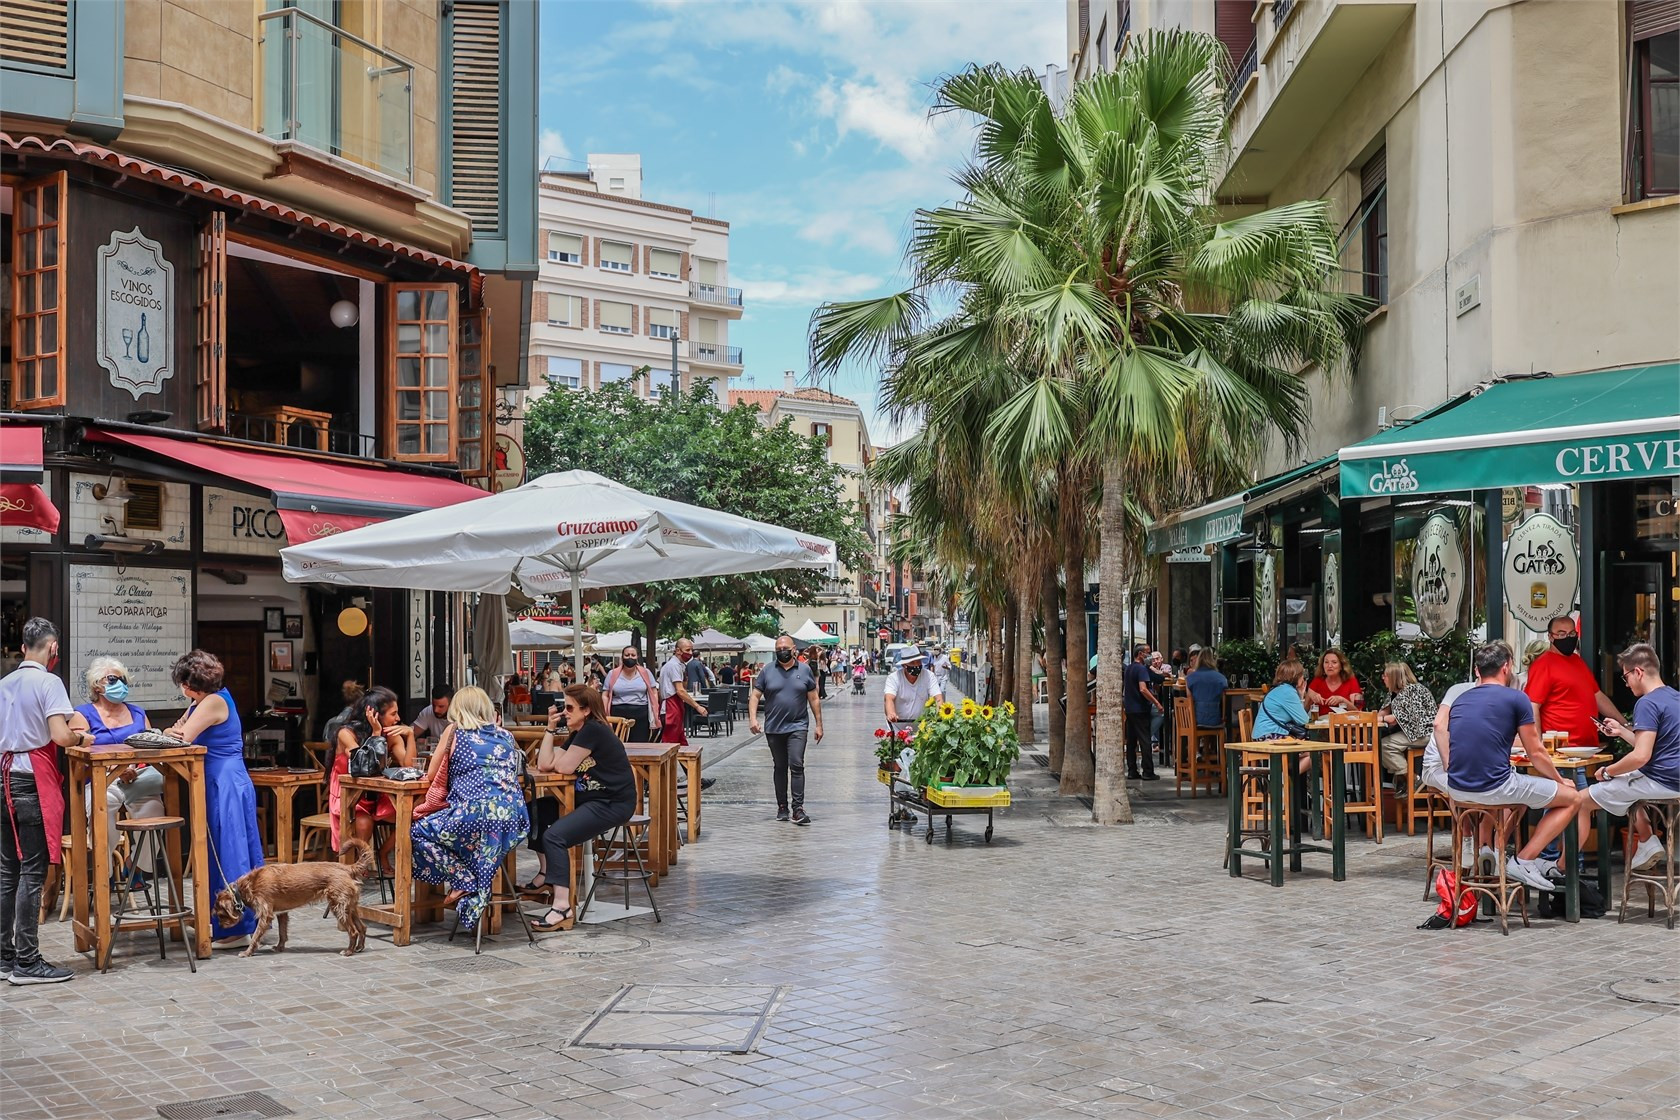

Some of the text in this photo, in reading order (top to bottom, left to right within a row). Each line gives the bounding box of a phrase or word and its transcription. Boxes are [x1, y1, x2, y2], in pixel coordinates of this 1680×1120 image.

[121, 278, 153, 296] VINOS
[111, 290, 162, 311] ESCOGIDOS
[1382, 458, 1409, 479] LOS
[1369, 470, 1419, 493] GATOS
[557, 519, 638, 537] Cruzcampo
[1517, 523, 1562, 542] CERVEZA TIRADA
[1527, 540, 1556, 558] LOS
[1513, 552, 1567, 575] GATOS
[114, 584, 127, 597] La
[98, 605, 168, 618] ALGO PARA PICAR
[1517, 602, 1565, 622] SISTEMA ANTIGUO
[414, 599, 422, 679] TAPAS
